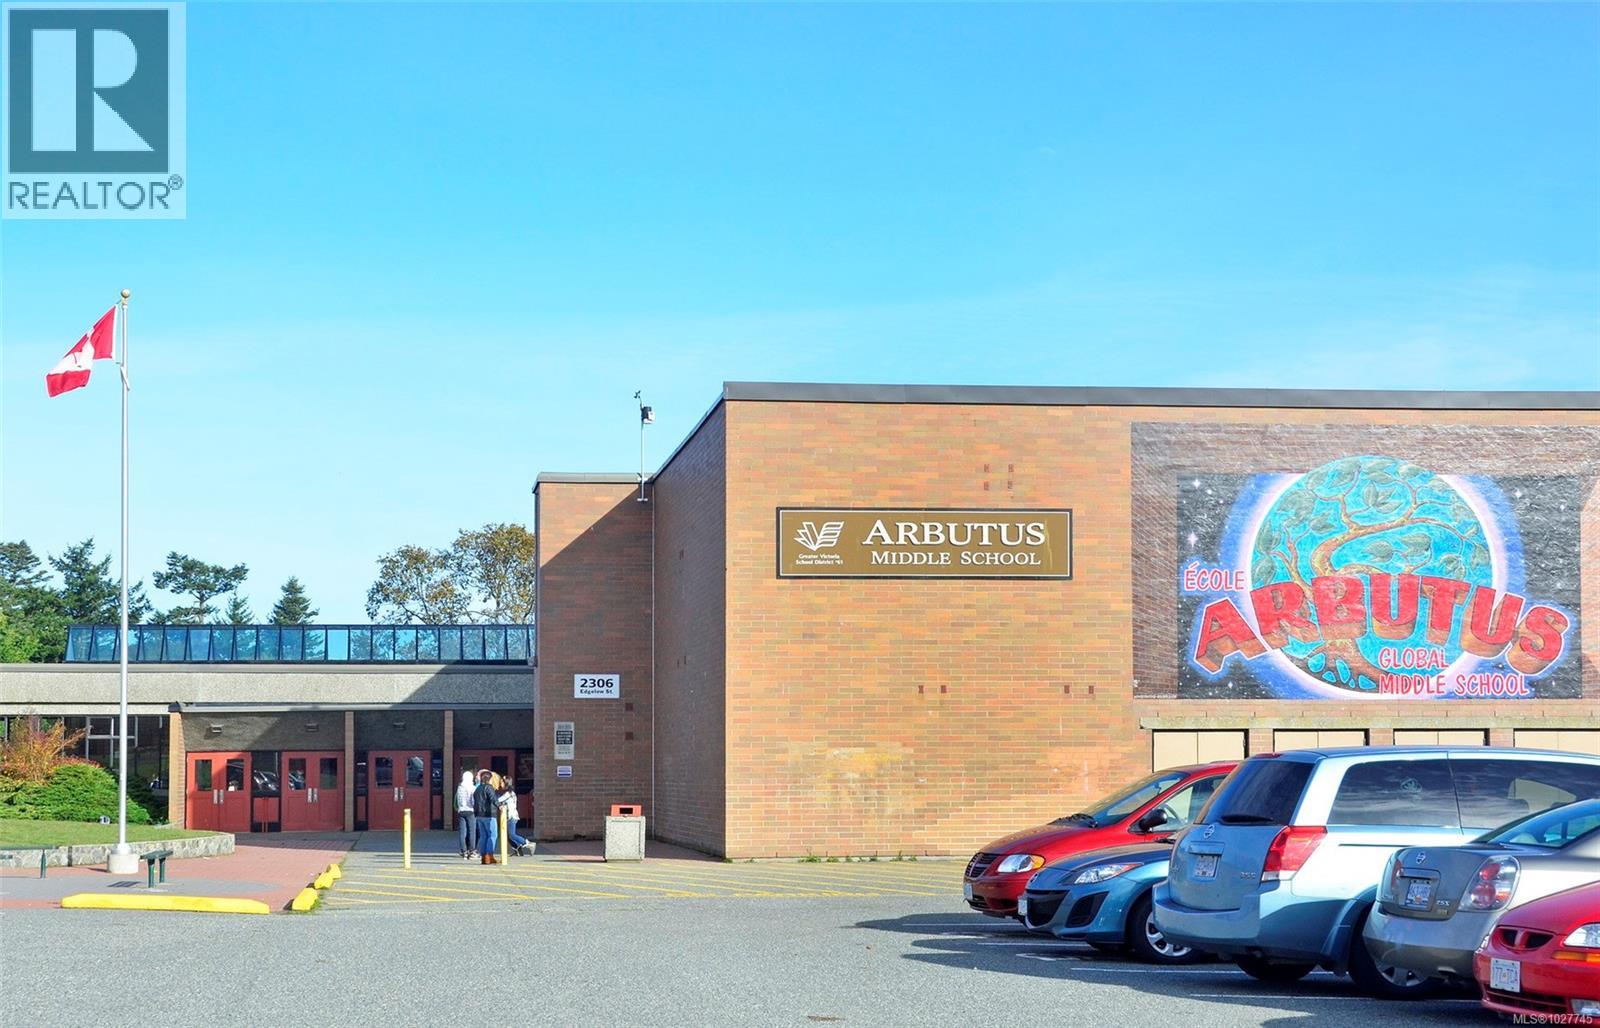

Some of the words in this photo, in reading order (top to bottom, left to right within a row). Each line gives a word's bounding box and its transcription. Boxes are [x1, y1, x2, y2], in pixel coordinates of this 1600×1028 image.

[862, 519, 1047, 546] ARBUTUS
[871, 550, 952, 565] MIDDLE
[960, 551, 1042, 566] SCHOOL
[1184, 561, 1245, 591] ÉCOLE
[1194, 573, 1570, 674] ARBUTUS
[1379, 647, 1449, 668] GLOBAL
[580, 678, 614, 688] 2306
[1378, 674, 1446, 695] MIDDLE
[1456, 674, 1530, 696] SCHOOL
